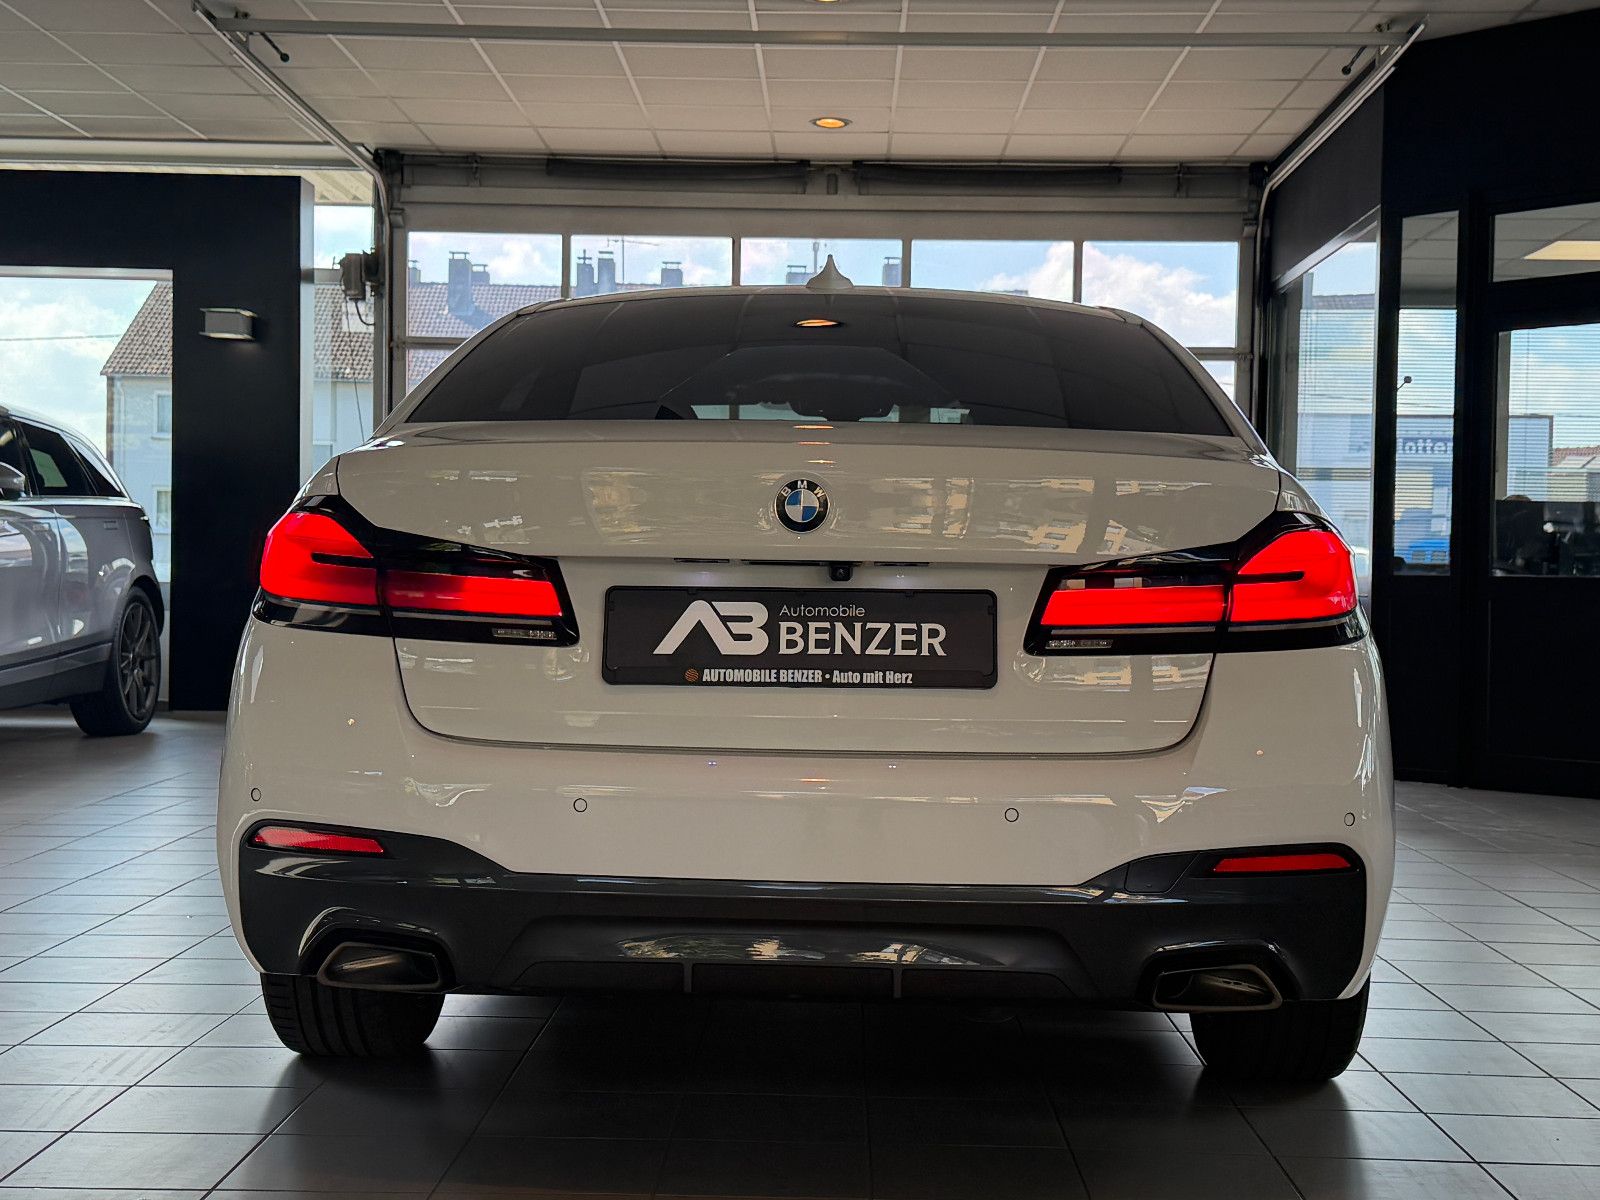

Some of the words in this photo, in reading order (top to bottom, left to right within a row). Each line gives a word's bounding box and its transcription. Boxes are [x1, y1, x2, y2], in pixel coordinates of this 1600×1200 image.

[781, 480, 826, 498] BMW
[779, 604, 865, 617] Automobile
[778, 621, 947, 656] BENZER
[702, 668, 777, 682] AUTOMOBILE
[779, 669, 823, 683] BENZER
[832, 670, 861, 684] Auto
[862, 670, 884, 684] mit
[885, 670, 913, 684] Herz
